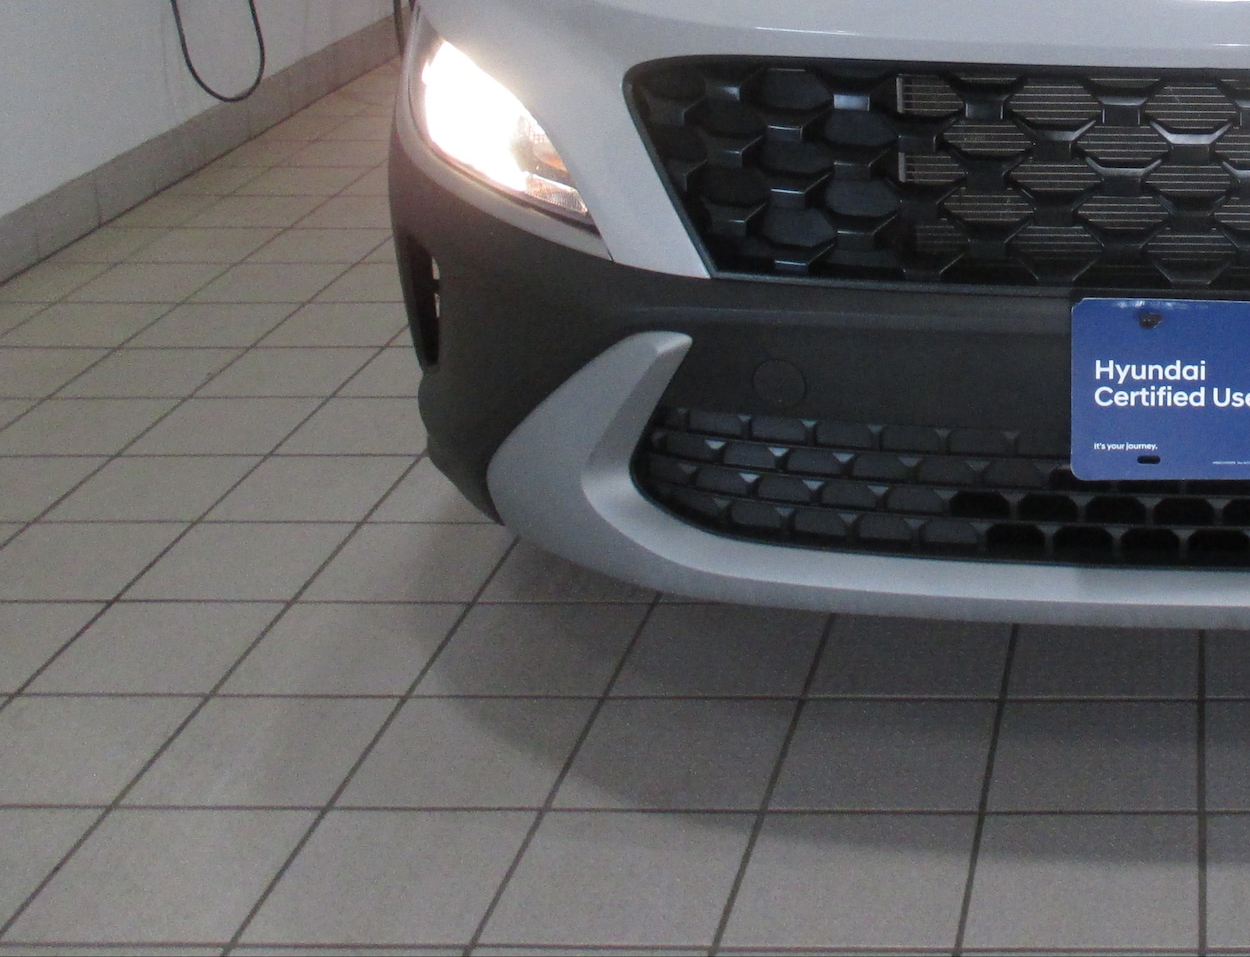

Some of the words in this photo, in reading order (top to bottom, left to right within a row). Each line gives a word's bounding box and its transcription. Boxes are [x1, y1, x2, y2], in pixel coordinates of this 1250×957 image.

[1094, 359, 1207, 385] Hyundai
[1093, 386, 1206, 408] Certified
[1106, 443, 1125, 452] your
[1125, 442, 1159, 452] journey.
